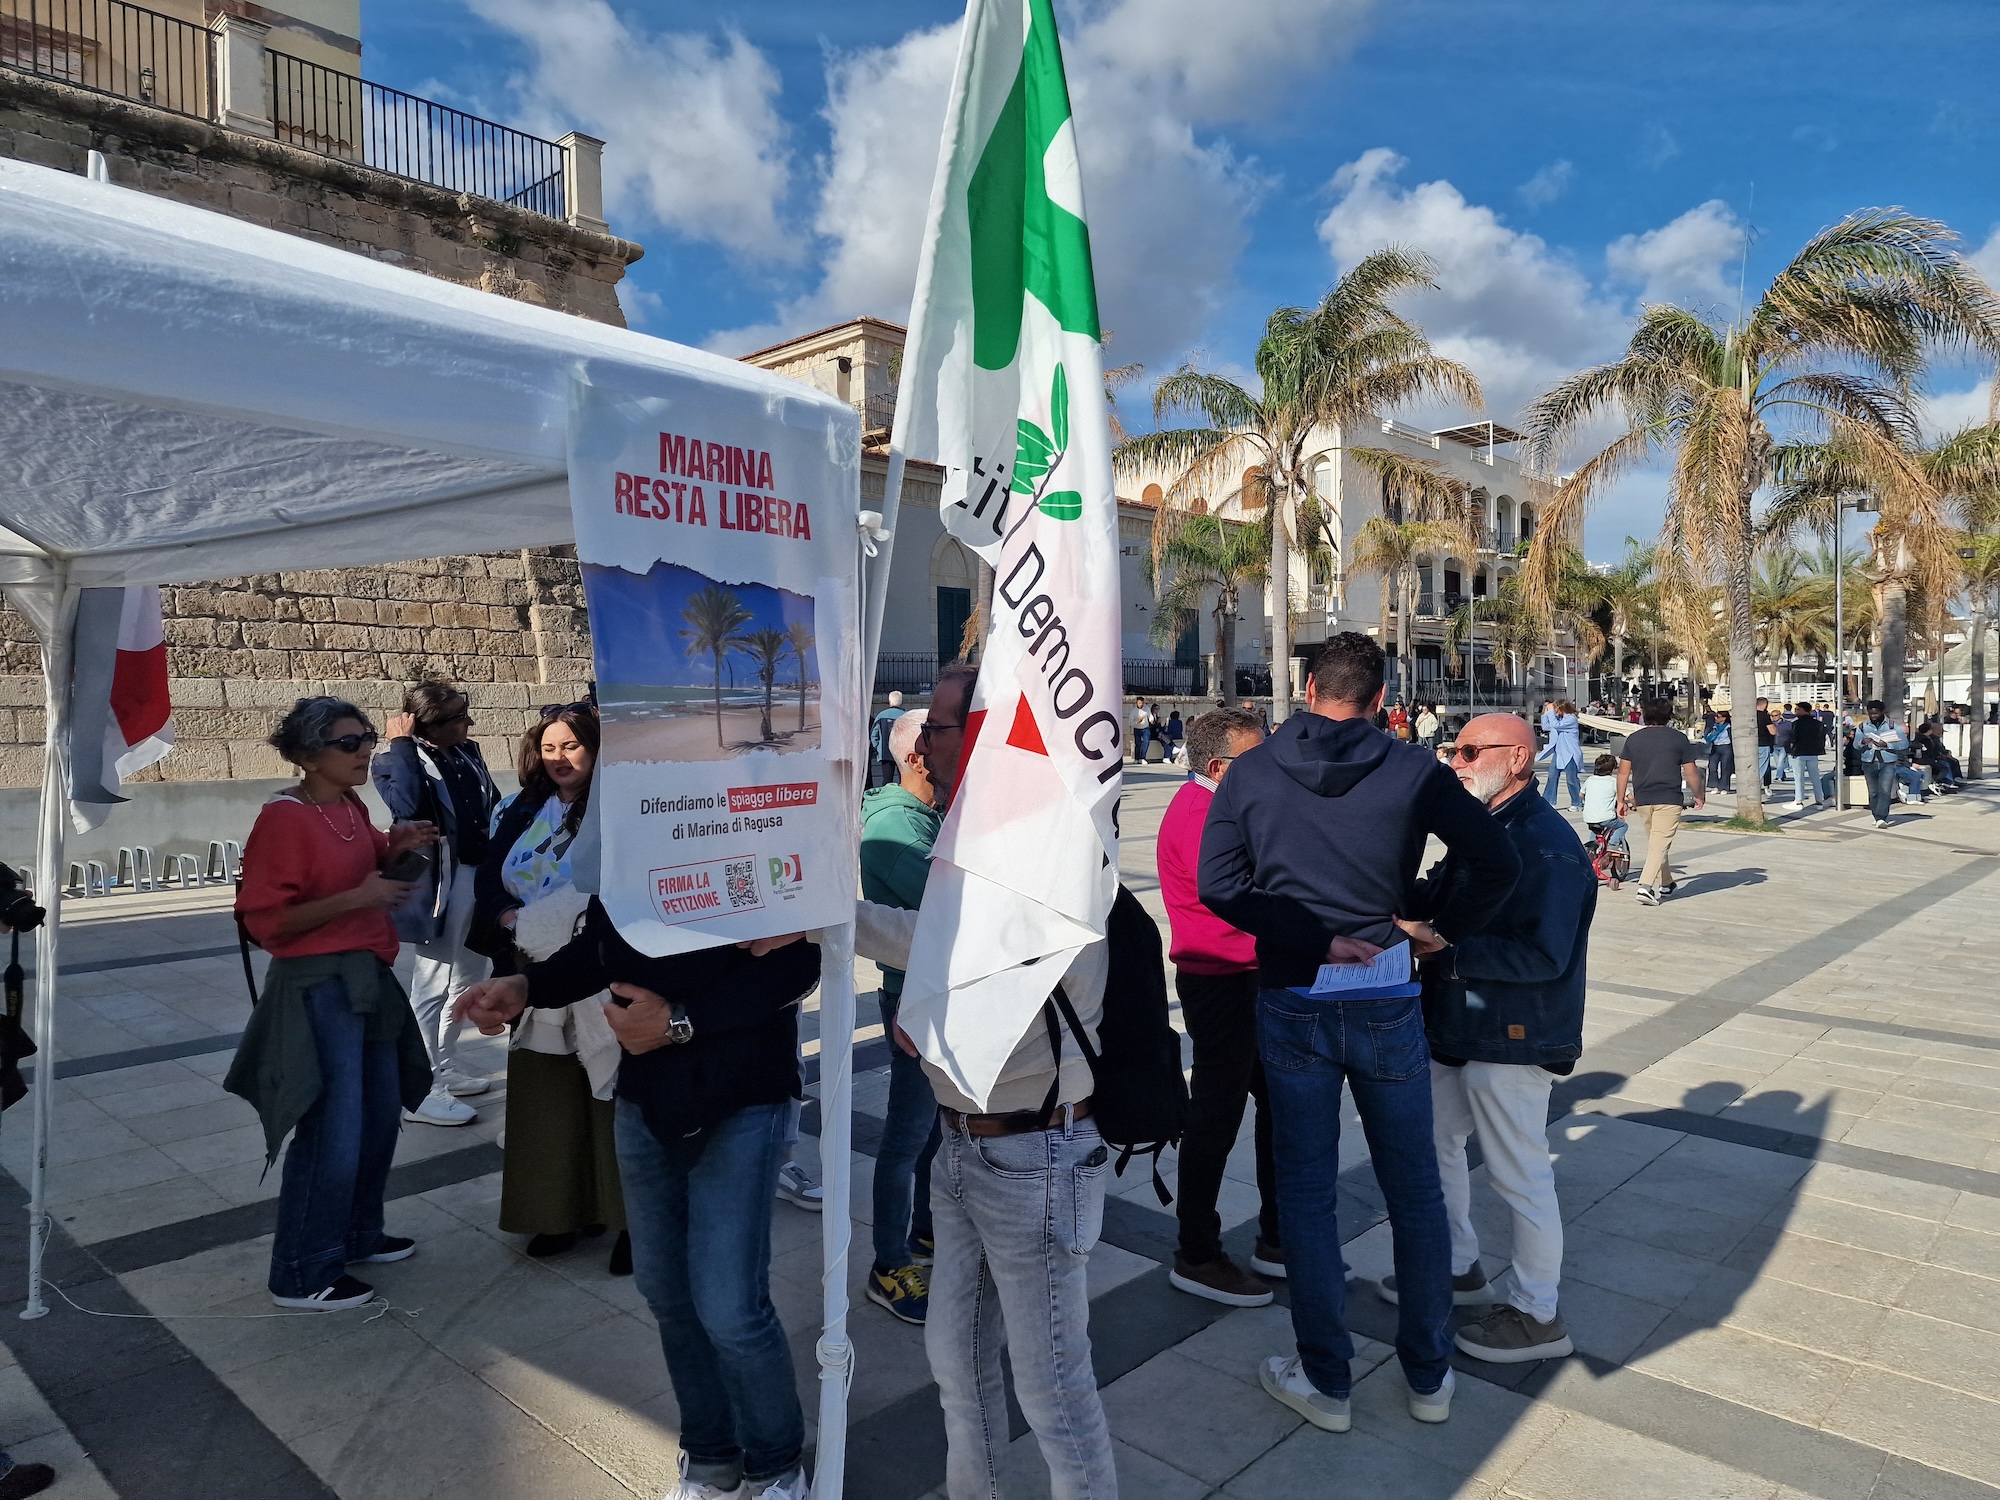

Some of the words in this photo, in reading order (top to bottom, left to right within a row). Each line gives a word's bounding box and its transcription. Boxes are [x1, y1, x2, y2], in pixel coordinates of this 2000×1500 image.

[659, 431, 775, 491] MARINA
[614, 471, 707, 527] RESTA
[719, 490, 811, 541] LIBERA
[999, 541, 1123, 839] Democr
[640, 795, 714, 815] Difendiamo
[717, 792, 727, 808] le
[731, 790, 773, 810] spiagge
[776, 787, 814, 802] libere
[672, 822, 684, 840] di
[687, 820, 729, 838] Marina
[732, 817, 742, 833] di
[744, 815, 783, 833] Ragusa
[657, 873, 695, 896] FIRMA
[695, 871, 711, 889] LA
[768, 854, 803, 887] PD
[661, 890, 721, 916] PETIZIONE
